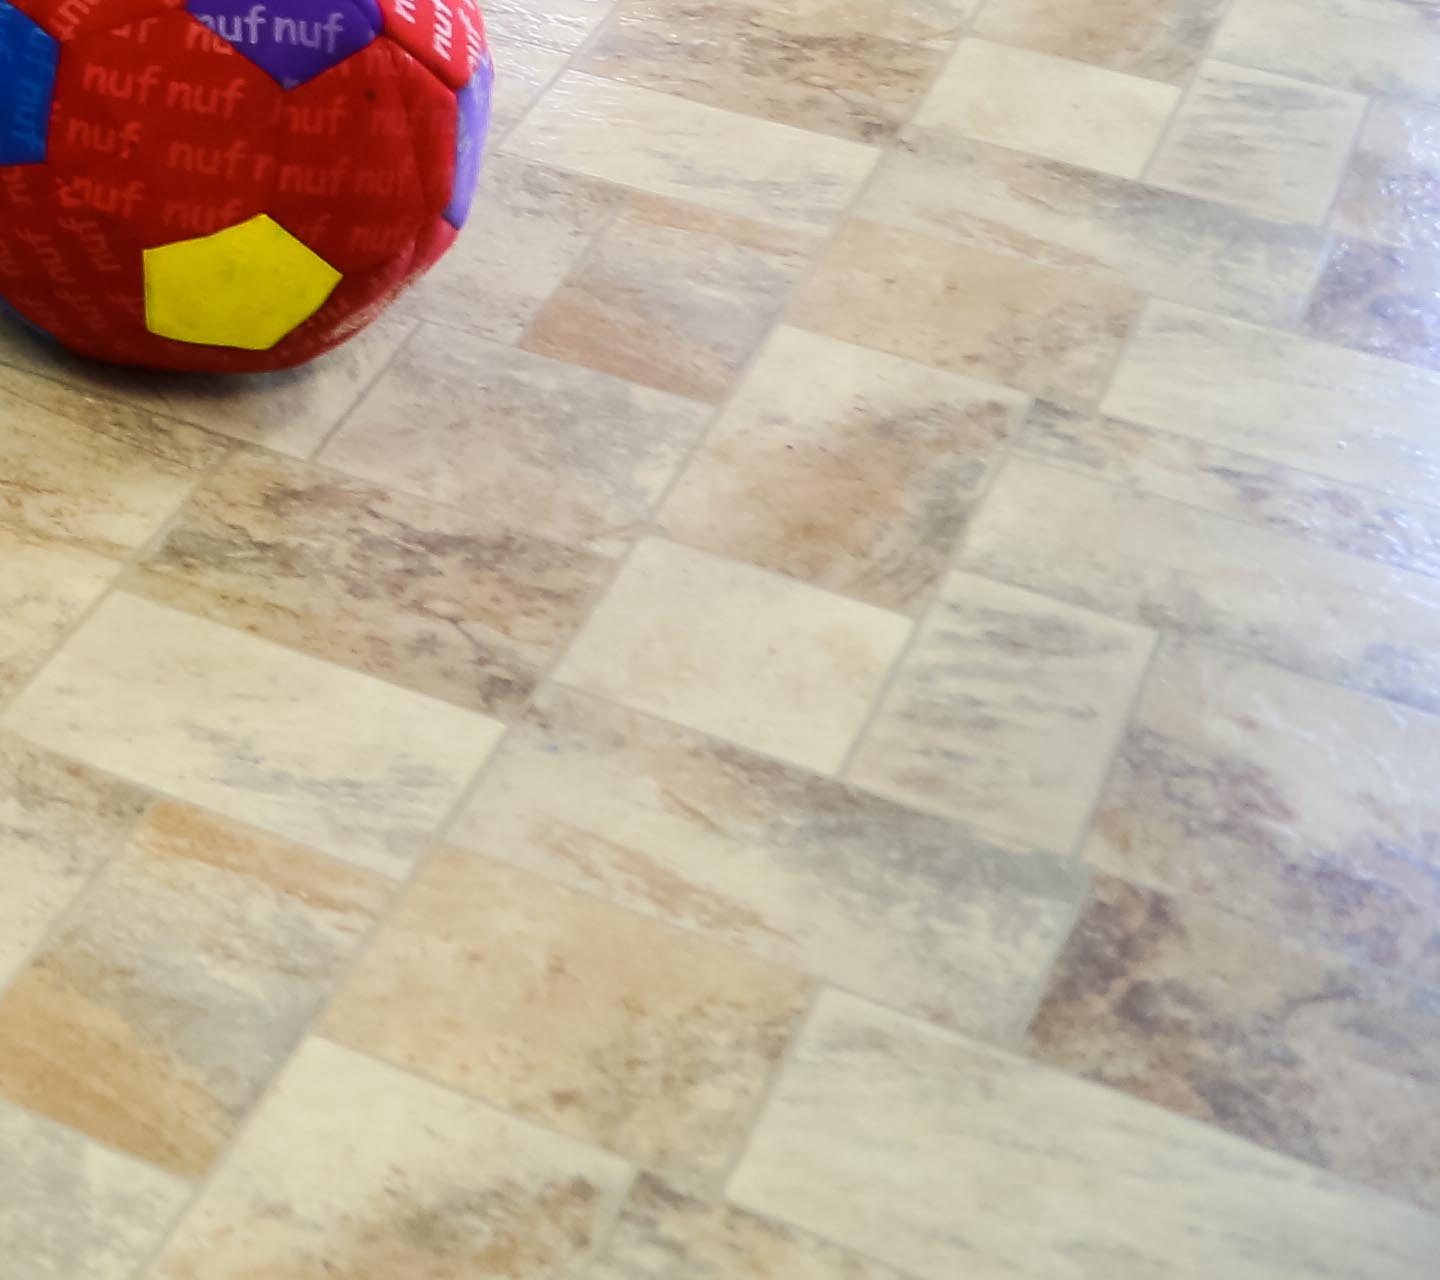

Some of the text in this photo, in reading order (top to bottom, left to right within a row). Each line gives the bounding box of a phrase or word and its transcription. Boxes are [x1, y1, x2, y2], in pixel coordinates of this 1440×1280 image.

[274, 12, 345, 53] nuf
[82, 62, 245, 121] nuf nuf
[168, 139, 248, 181] nuf
